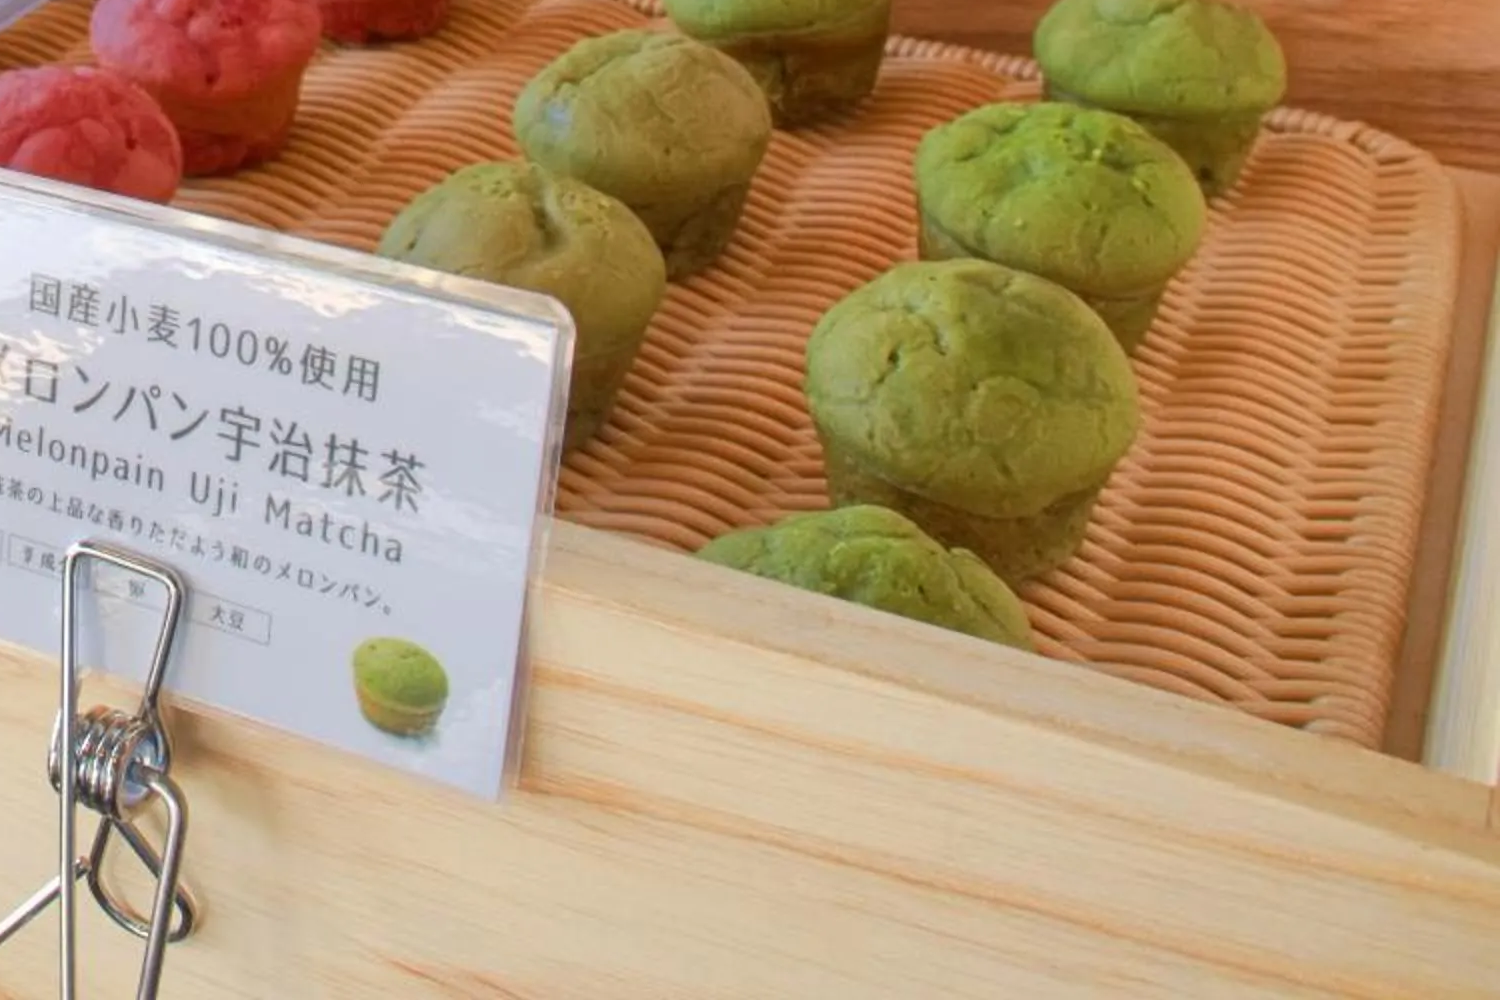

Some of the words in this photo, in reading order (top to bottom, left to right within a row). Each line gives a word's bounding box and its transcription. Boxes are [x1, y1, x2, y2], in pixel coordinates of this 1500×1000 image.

[30, 272, 381, 403] 国産小麦100%使用
[190, 470, 240, 518] Uji
[264, 493, 404, 564] Matcha
[210, 604, 246, 632] 大豆
